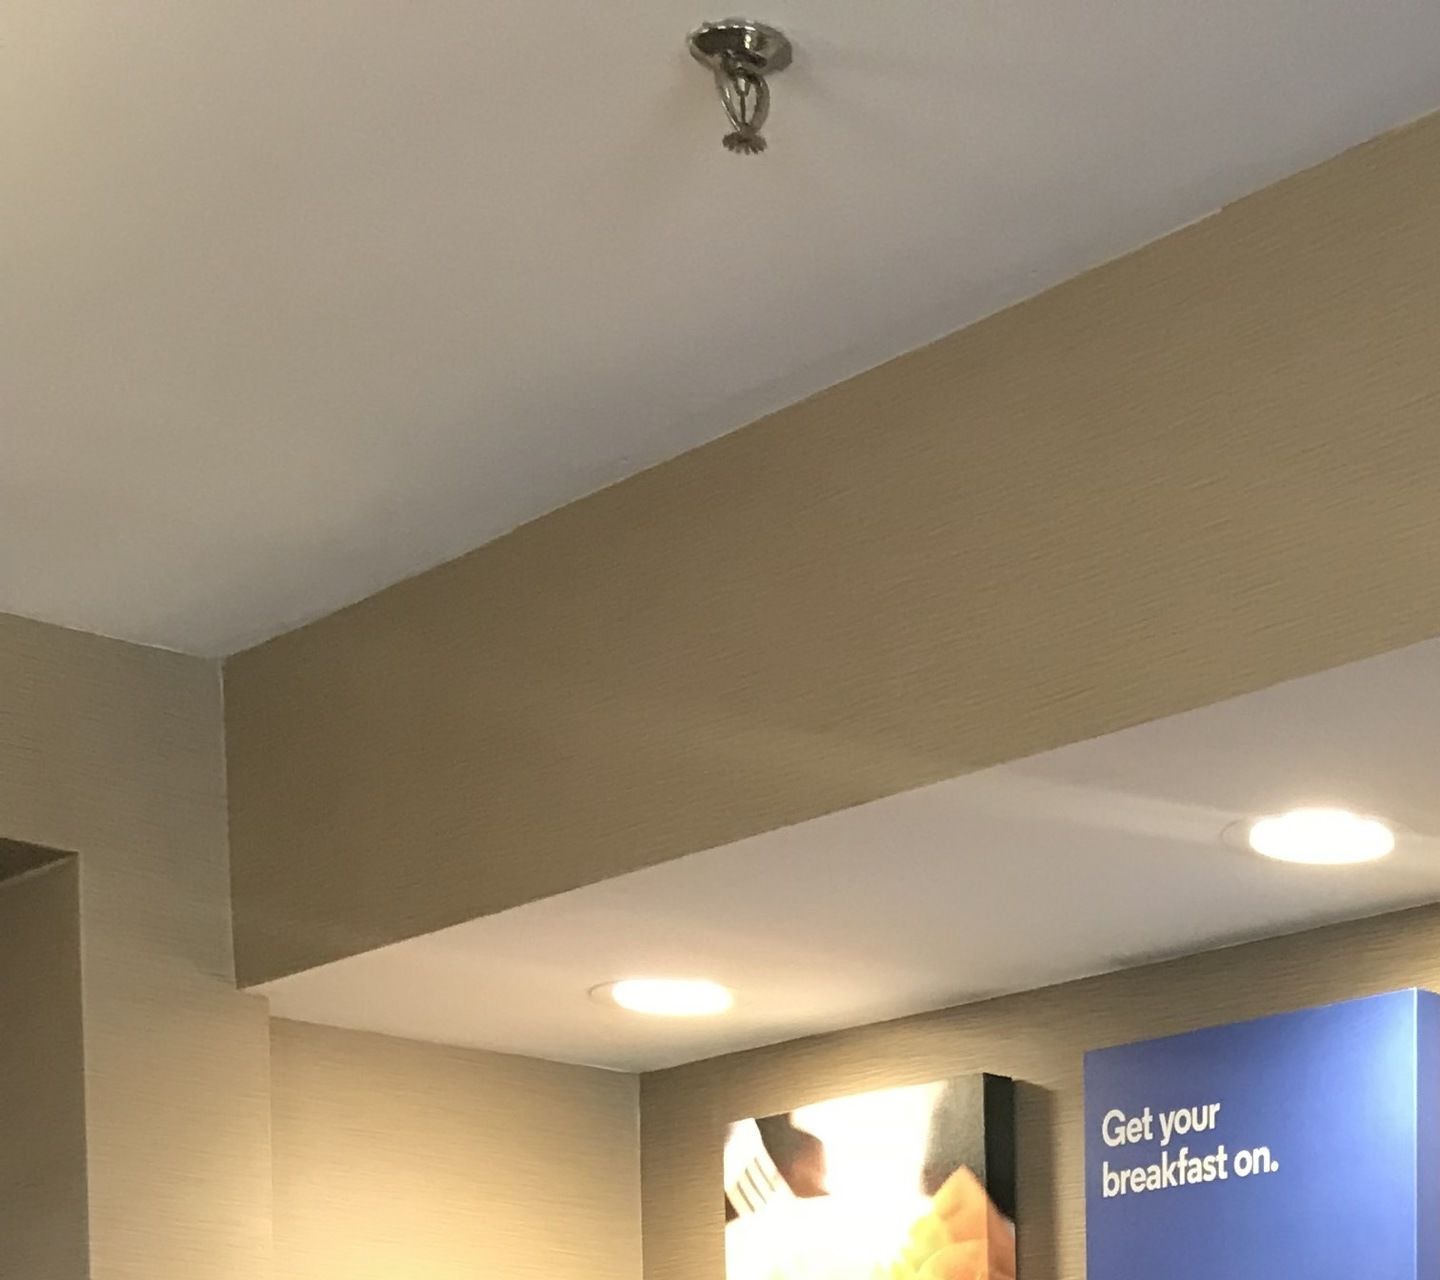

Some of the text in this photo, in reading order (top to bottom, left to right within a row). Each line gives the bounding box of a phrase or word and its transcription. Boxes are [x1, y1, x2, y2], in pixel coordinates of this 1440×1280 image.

[1101, 1102, 1221, 1147] Get your
[1102, 1144, 1280, 1198] breakfast on.
